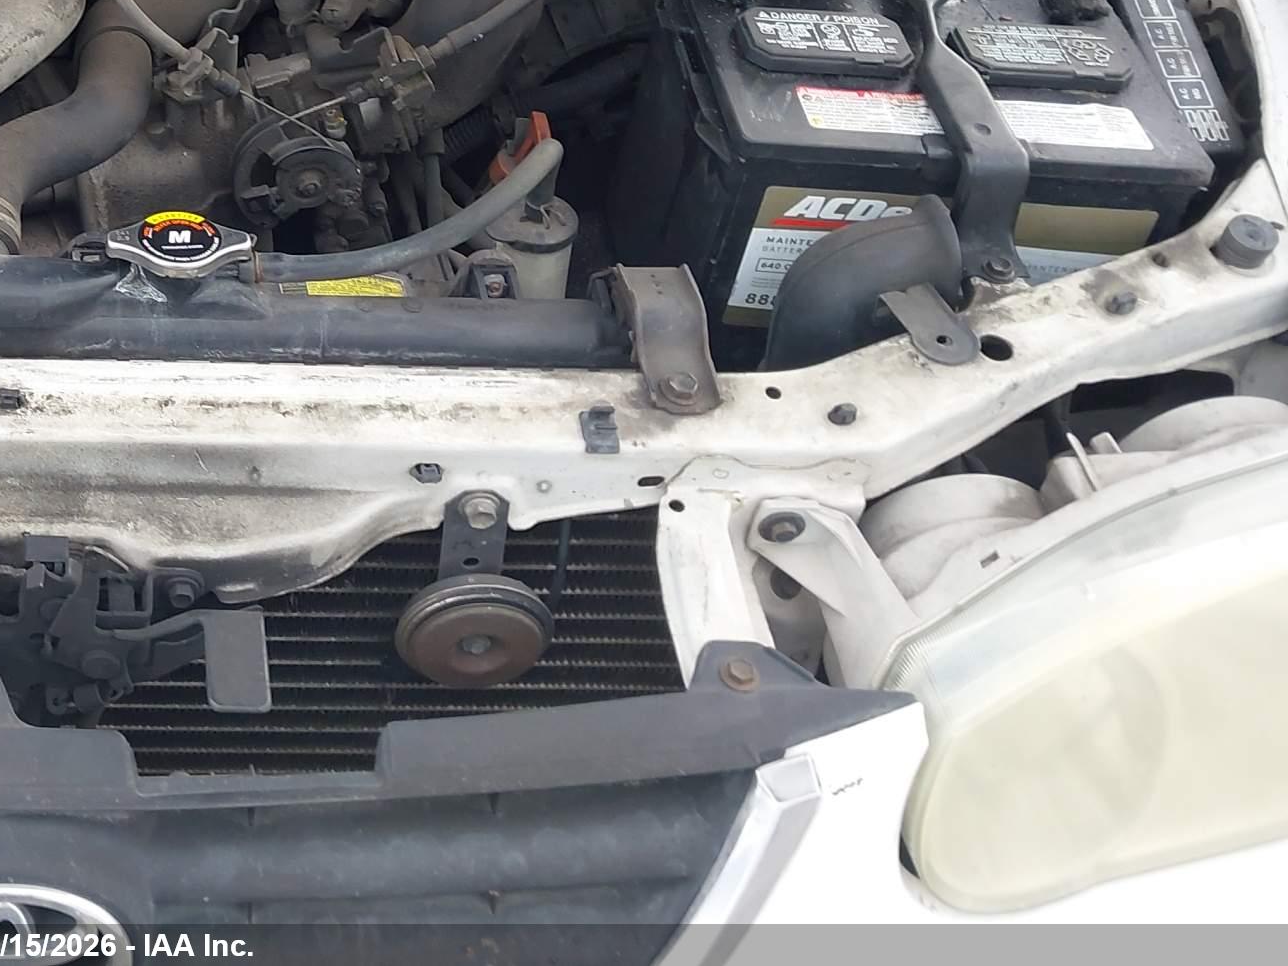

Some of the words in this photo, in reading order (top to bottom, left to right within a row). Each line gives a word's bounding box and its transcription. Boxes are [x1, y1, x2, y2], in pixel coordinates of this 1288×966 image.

[770, 11, 821, 22] DANGER
[833, 15, 880, 26] POISON
[168, 230, 191, 244] M
[760, 262, 782, 270] 640
